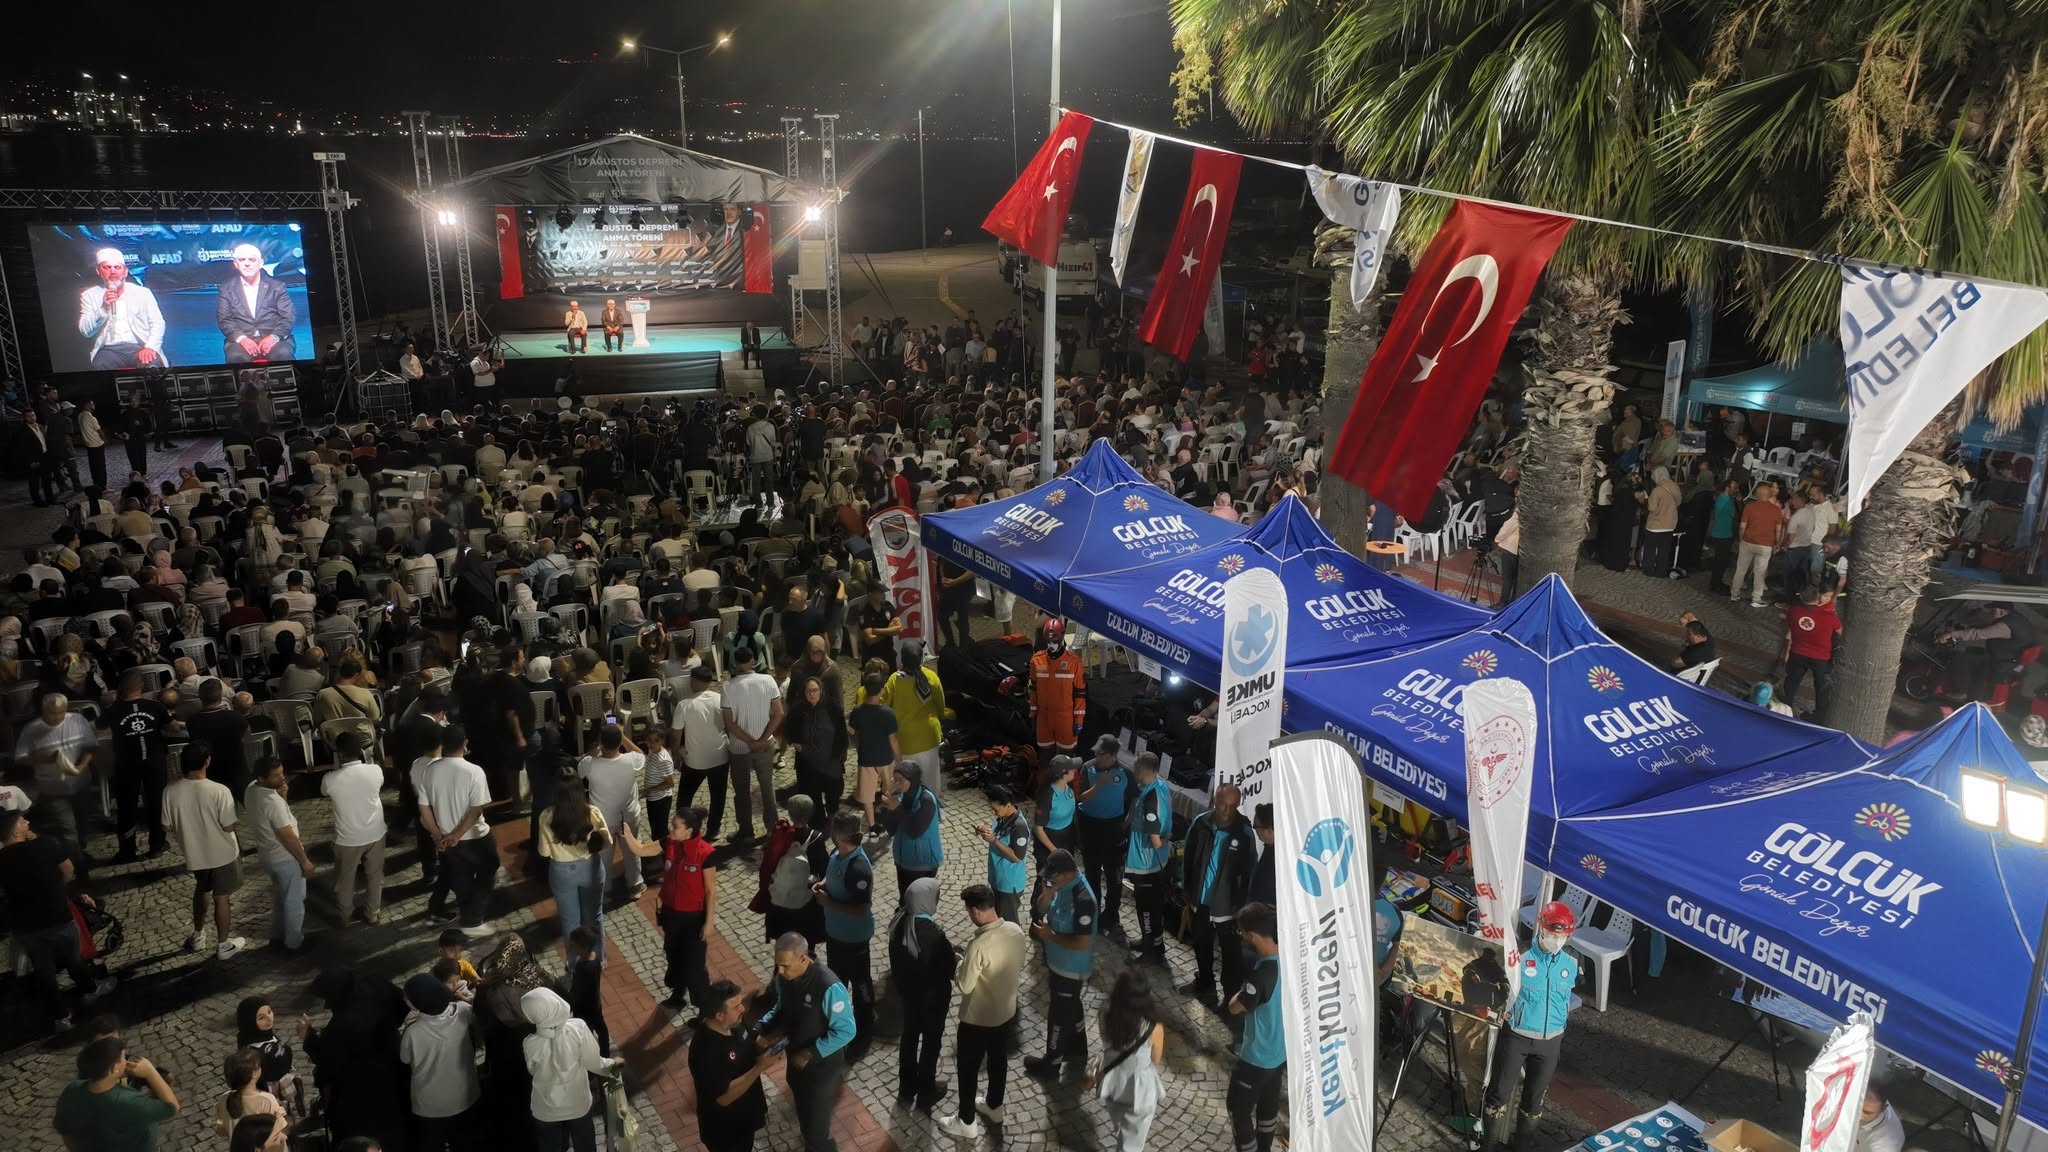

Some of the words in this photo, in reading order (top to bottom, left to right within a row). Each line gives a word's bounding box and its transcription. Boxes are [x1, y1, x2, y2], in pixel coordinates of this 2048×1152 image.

[597, 168, 628, 178] ANMA
[603, 234, 630, 242] ANMA
[632, 232, 664, 241] TÖRENİ
[640, 223, 679, 232] DEPREMİ
[152, 252, 182, 264] AFAD
[994, 516, 1045, 543] BELEDİYESİ
[1124, 532, 1200, 551] BELEDİYESİ
[1155, 586, 1221, 619] BELEDİYESİ
[1321, 608, 1406, 631] BELEDİYESİ
[1398, 668, 1464, 716] GÖLC
[1382, 688, 1464, 734] BELEDİYE
[1583, 695, 1690, 743] GÖLCÜK
[1609, 722, 1704, 758] BELEDİYESİ
[1372, 744, 1447, 801] BELEDİYESİ
[1764, 822, 1944, 915] GÖLCÜK
[1746, 850, 1915, 929] BELEDİYESİ
[1666, 895, 1750, 954] GÖLCÜK
[1751, 935, 1888, 1025] BELEDİYESİ
